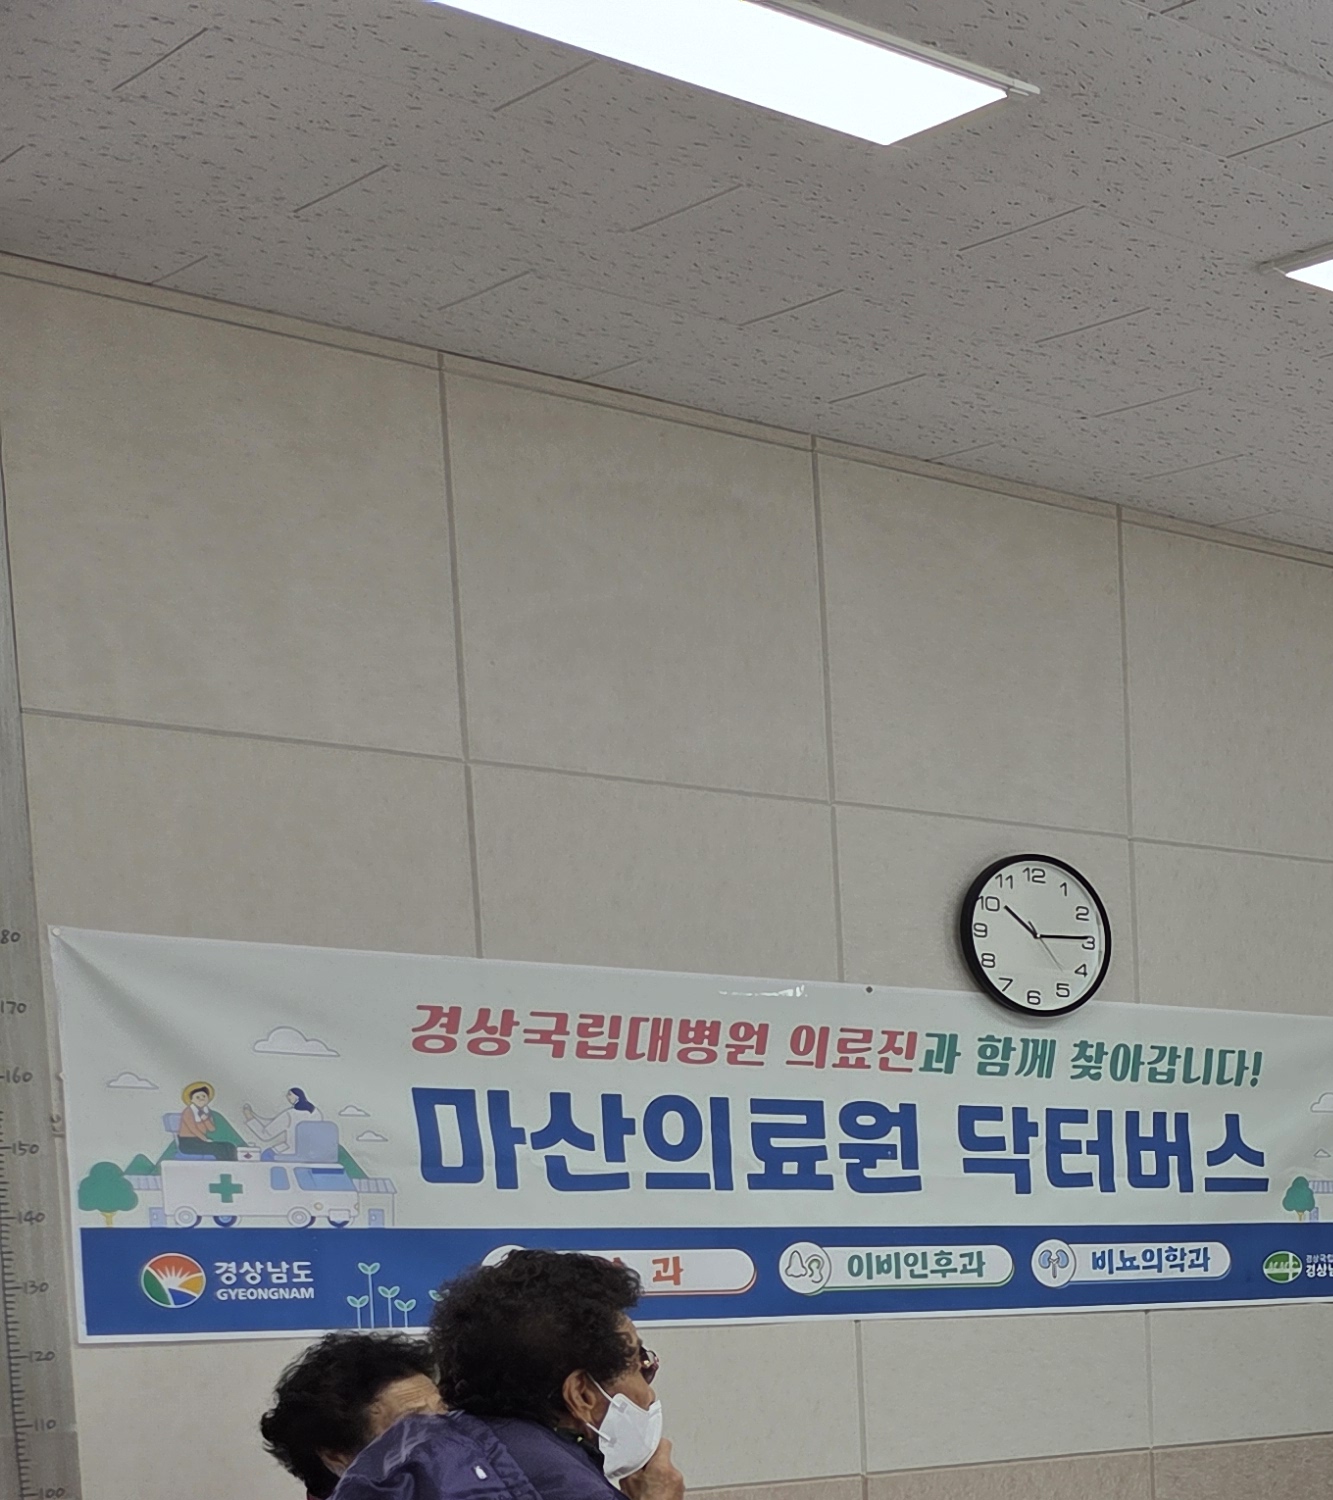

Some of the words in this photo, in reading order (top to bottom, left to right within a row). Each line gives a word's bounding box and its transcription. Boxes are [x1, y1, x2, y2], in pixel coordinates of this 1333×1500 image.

[995, 874, 1014, 889] 11
[1022, 867, 1046, 884] 12
[1060, 882, 1068, 896] 1
[977, 896, 1000, 912] 10
[1075, 906, 1090, 921] 2
[974, 922, 988, 938] 9
[1081, 936, 1096, 950] 3
[981, 952, 996, 968] 8
[1074, 964, 1088, 978] 4
[998, 977, 1013, 992] 7
[1056, 982, 1070, 998] 5
[1026, 990, 1042, 1006] 6
[411, 1004, 770, 1067] 경상국립대병원
[785, 1024, 962, 1075] 의료진과
[976, 1034, 1056, 1079] 함께
[1069, 1039, 1264, 1088] 찾아갑니다!
[5, 1068, 33, 1085] 160
[411, 1086, 922, 1194] 마산의료원
[956, 1103, 1270, 1195] 닥터버스
[11, 1142, 40, 1157] 150
[17, 1211, 46, 1225] 140
[847, 1250, 986, 1280] 이비인후과
[1091, 1246, 1211, 1274] 비뇨의학과
[214, 1259, 314, 1286] 경상남도
[23, 1281, 50, 1294] 130
[215, 1286, 314, 1300] GYEONGNAM
[28, 1350, 56, 1363] 120
[33, 1419, 57, 1430] 110
[38, 1487, 66, 1500] 100
